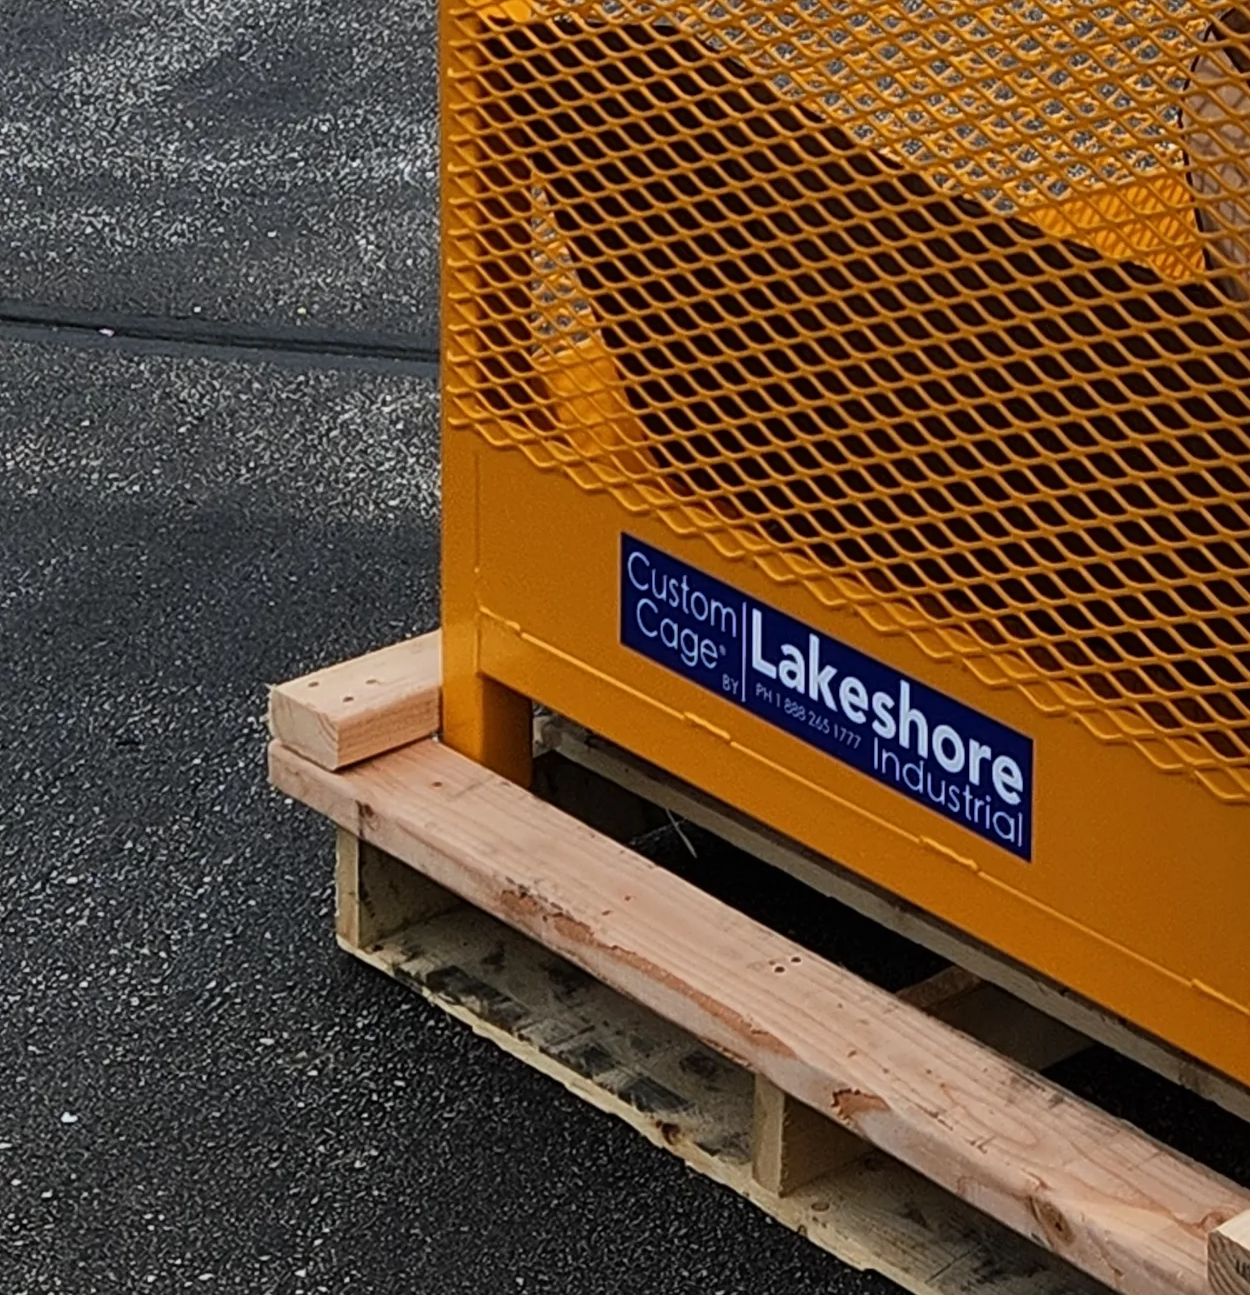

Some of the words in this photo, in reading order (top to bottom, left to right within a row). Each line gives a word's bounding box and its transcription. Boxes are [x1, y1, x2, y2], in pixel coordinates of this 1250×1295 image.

[627, 551, 737, 637] Custom
[722, 673, 738, 696] BY
[752, 609, 1024, 806] Lakeshore
[755, 682, 773, 704] PH
[776, 693, 781, 708] 1
[808, 710, 831, 735] 265
[833, 723, 862, 750] 1777
[873, 737, 1023, 848] Industrial
